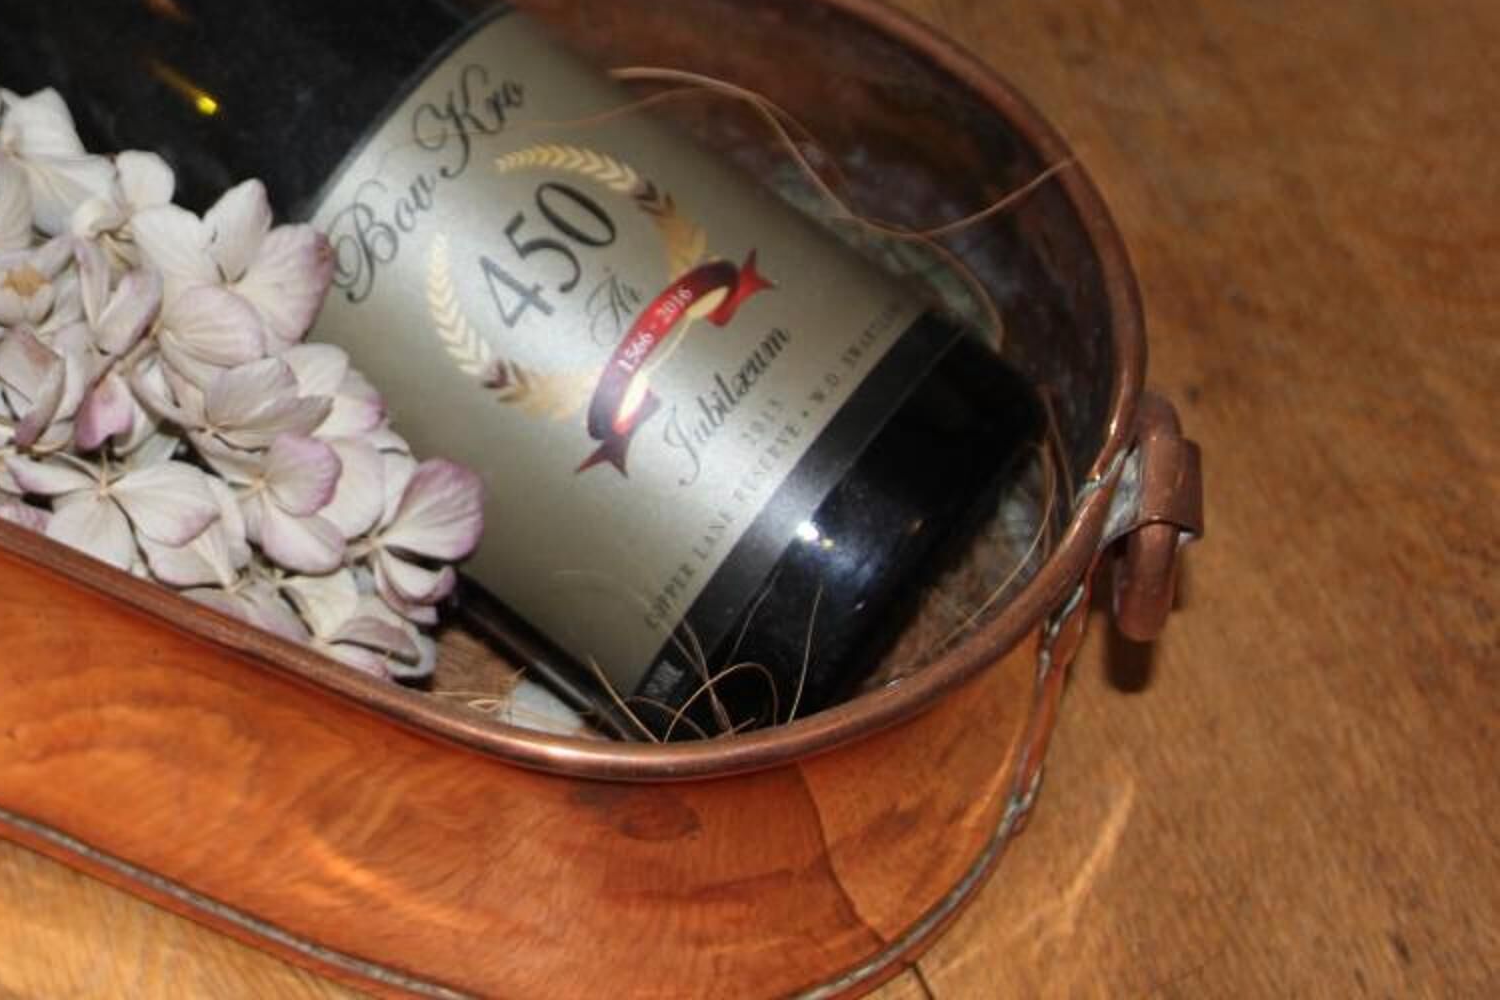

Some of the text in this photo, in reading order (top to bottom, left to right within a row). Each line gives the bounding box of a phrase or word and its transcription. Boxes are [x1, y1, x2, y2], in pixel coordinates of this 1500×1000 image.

[412, 63, 524, 179] Kro
[480, 182, 617, 328] 450
[617, 331, 654, 373] 1566
[657, 286, 693, 322] 2016
[664, 326, 791, 486] Jubilæum
[693, 511, 734, 560] LANE
